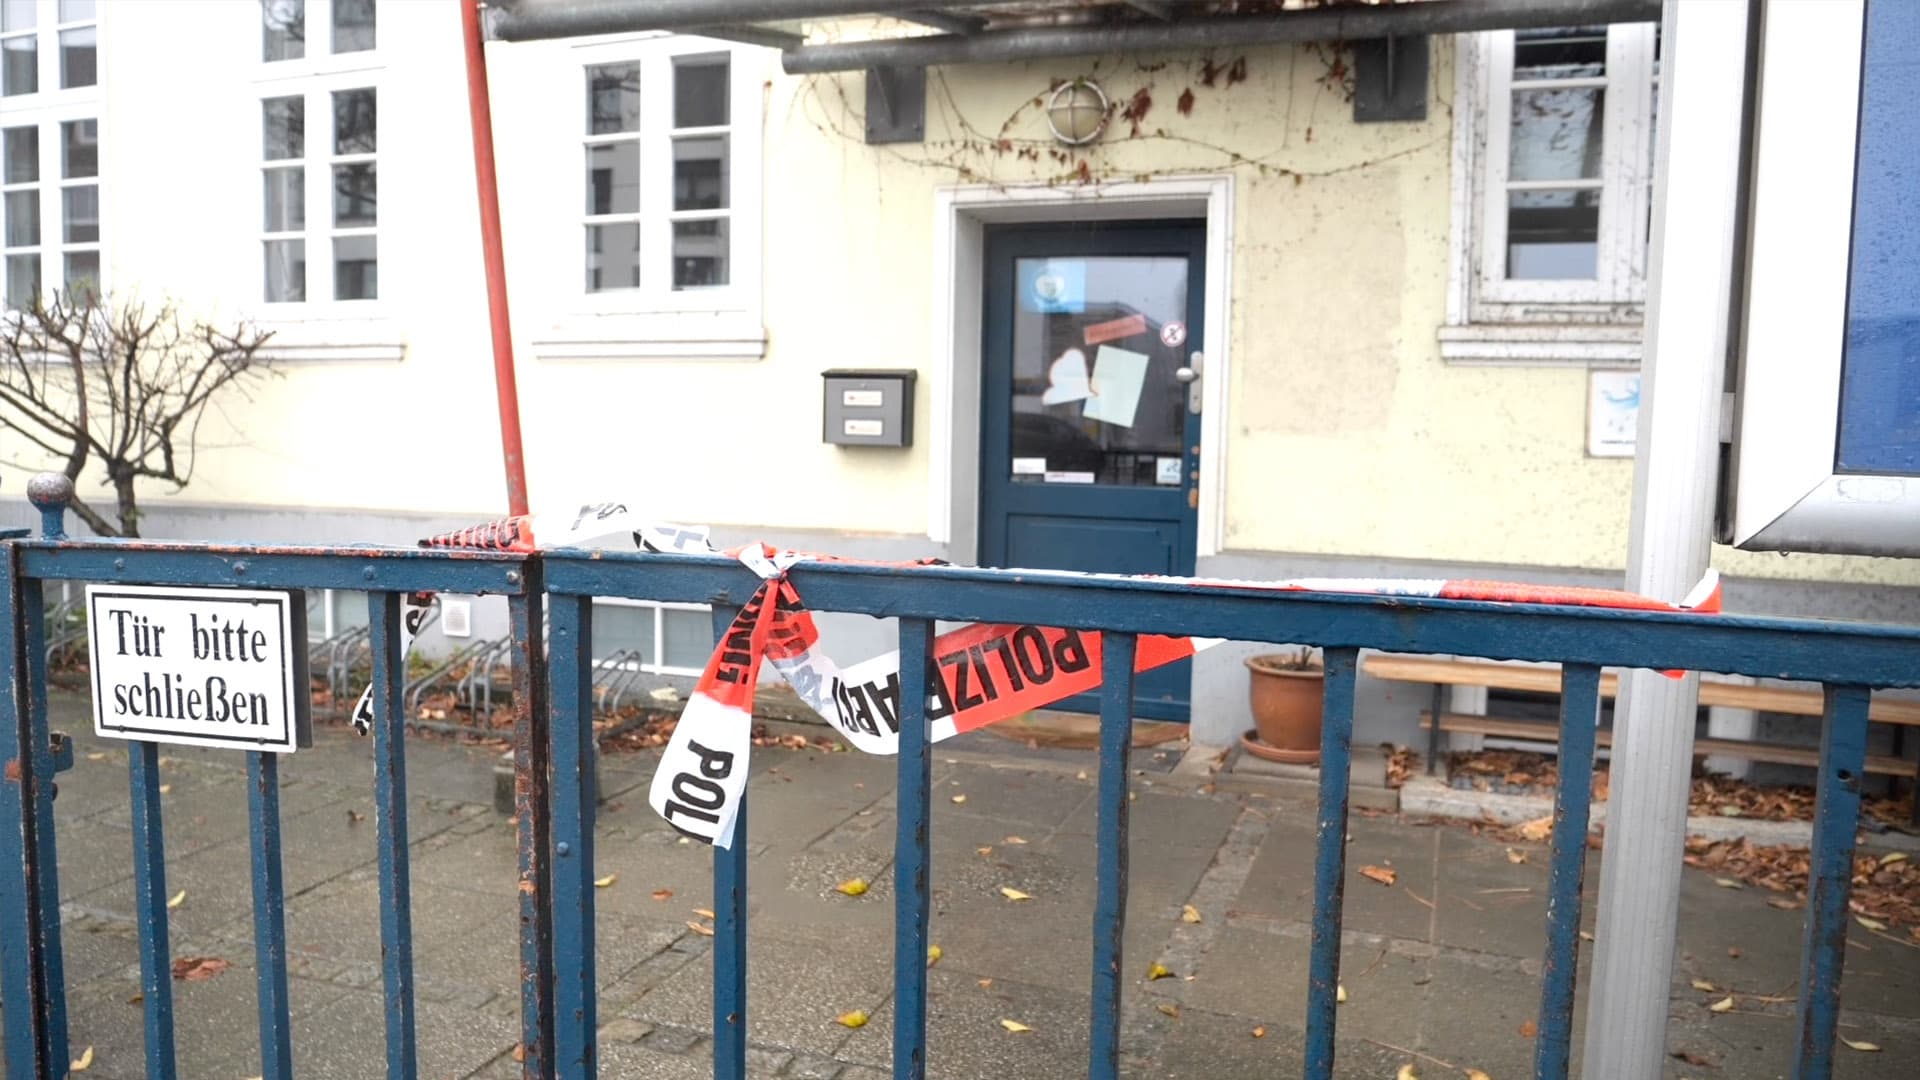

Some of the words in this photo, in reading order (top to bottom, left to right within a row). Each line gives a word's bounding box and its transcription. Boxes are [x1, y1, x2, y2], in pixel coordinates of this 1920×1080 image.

[109, 609, 166, 658] Tür
[189, 613, 267, 663] bitte
[114, 672, 270, 726] schließen
